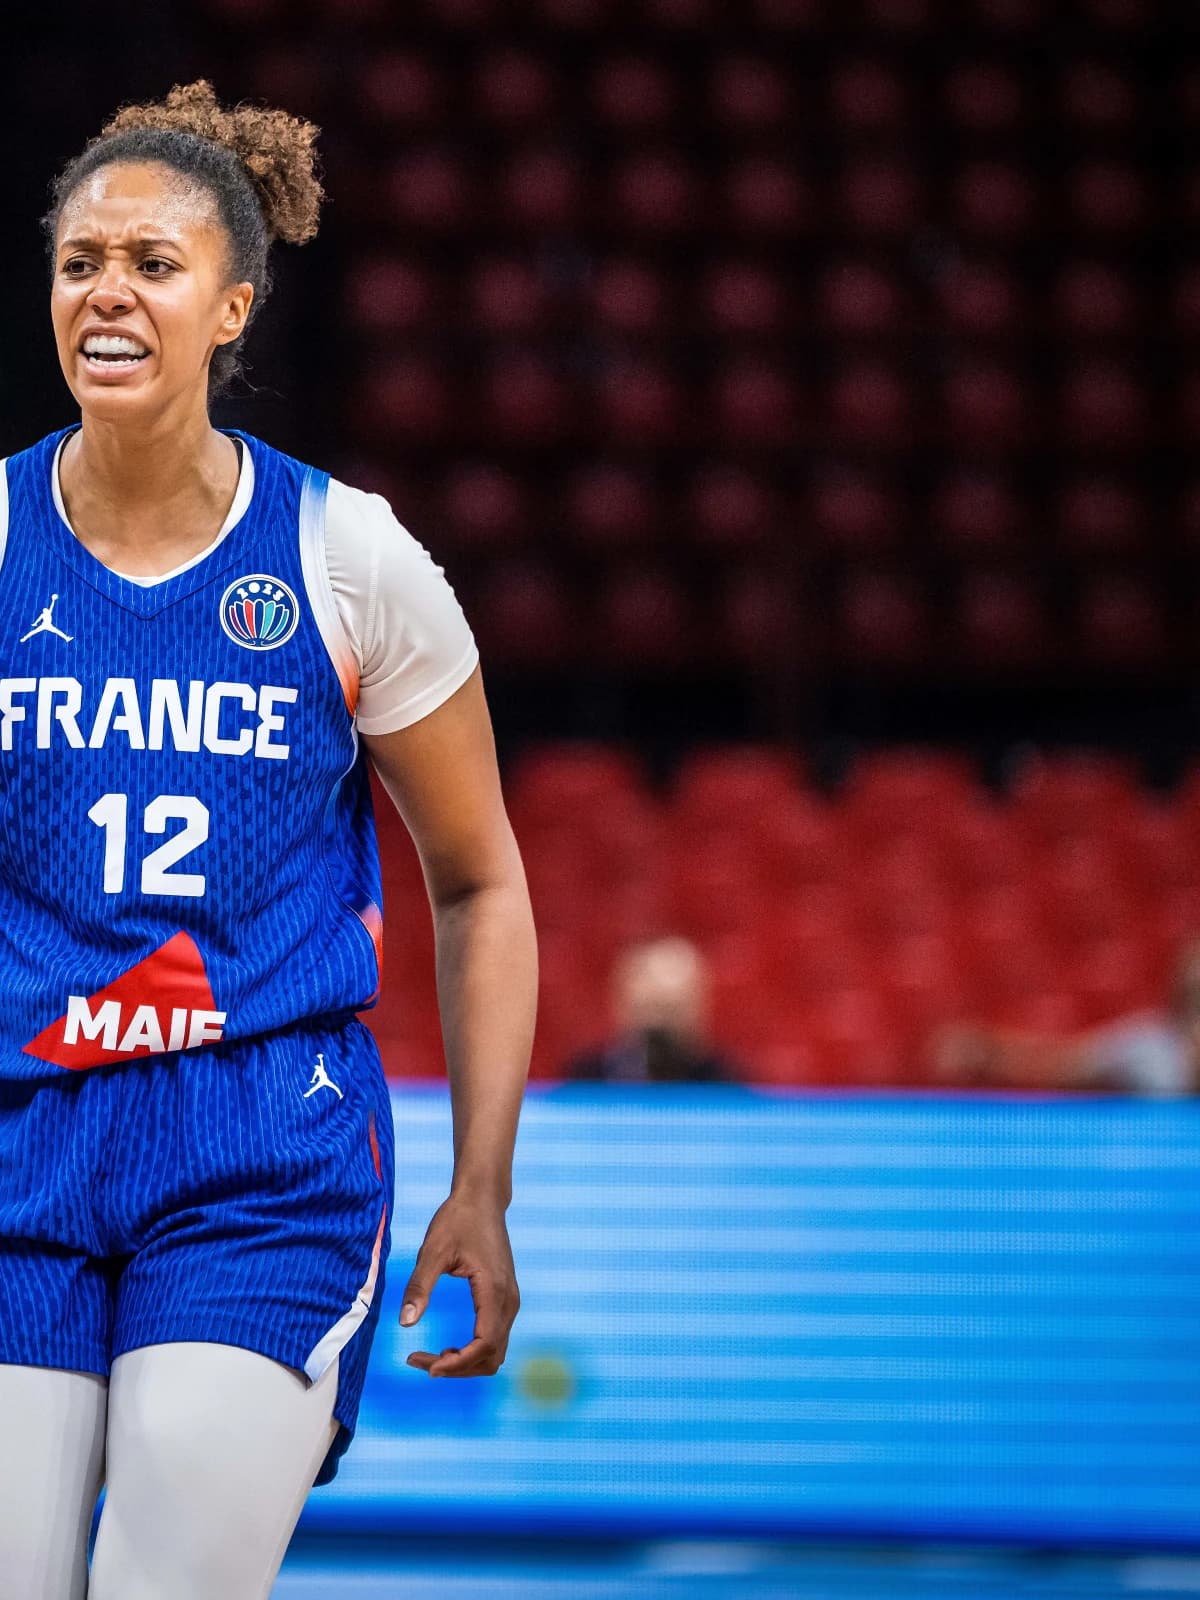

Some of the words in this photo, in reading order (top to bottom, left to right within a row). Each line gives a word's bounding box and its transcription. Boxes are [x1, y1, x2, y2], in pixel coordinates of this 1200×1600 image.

[236, 581, 285, 602] 2025
[0, 677, 298, 760] FRANCE
[88, 793, 209, 897] 12
[63, 995, 227, 1053] MAIF
